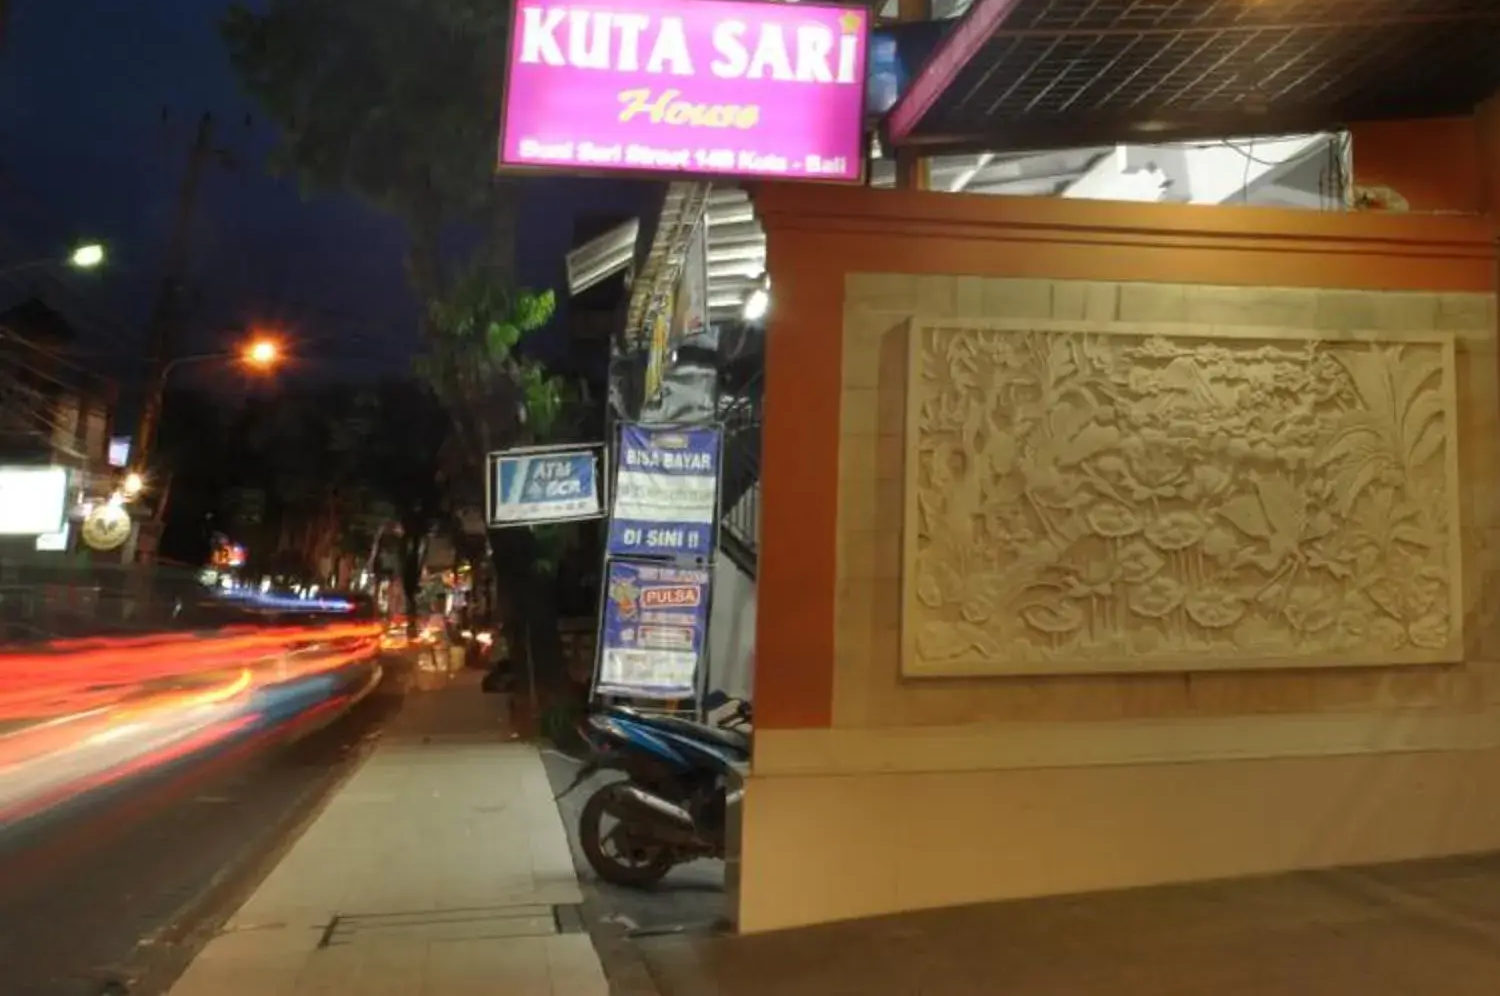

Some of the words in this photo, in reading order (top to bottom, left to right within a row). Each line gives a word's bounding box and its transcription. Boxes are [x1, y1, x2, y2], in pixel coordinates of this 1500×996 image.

[520, 7, 696, 76] KUTA
[617, 86, 759, 130] House
[533, 460, 571, 479] ATM
[627, 449, 659, 466] BISA
[663, 452, 711, 470] BAYAR
[623, 529, 642, 545] DI
[647, 530, 683, 547] SINI
[647, 589, 697, 603] PULSA
